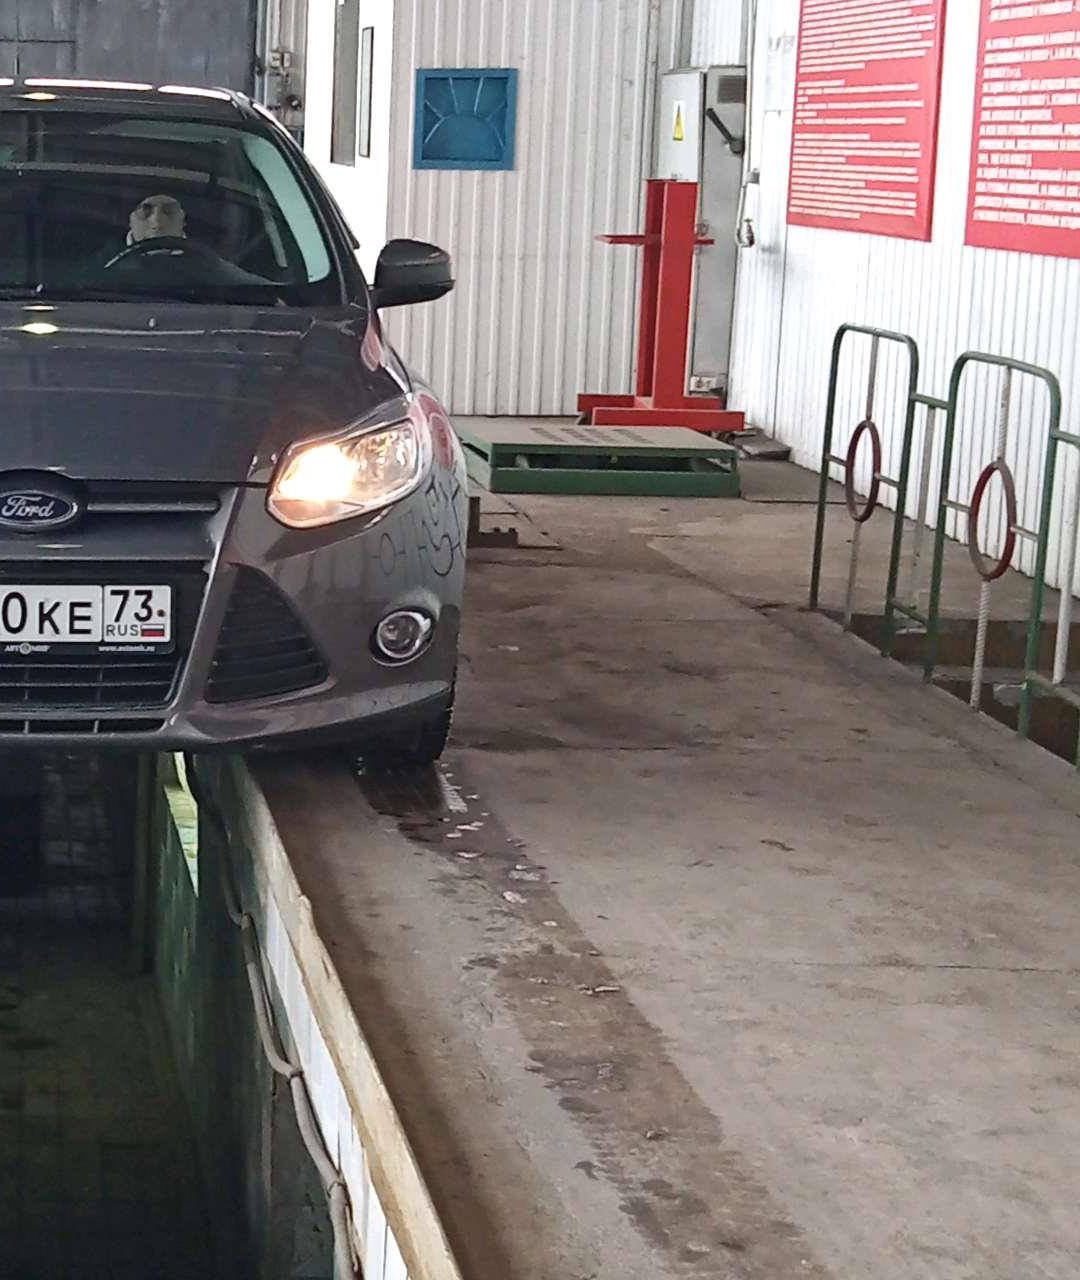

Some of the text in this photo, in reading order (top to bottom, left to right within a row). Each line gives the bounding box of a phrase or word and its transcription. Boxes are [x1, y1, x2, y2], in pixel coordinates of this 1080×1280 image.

[1, 495, 55, 517] Ford
[110, 589, 153, 623] 73
[106, 624, 139, 637] RUS
